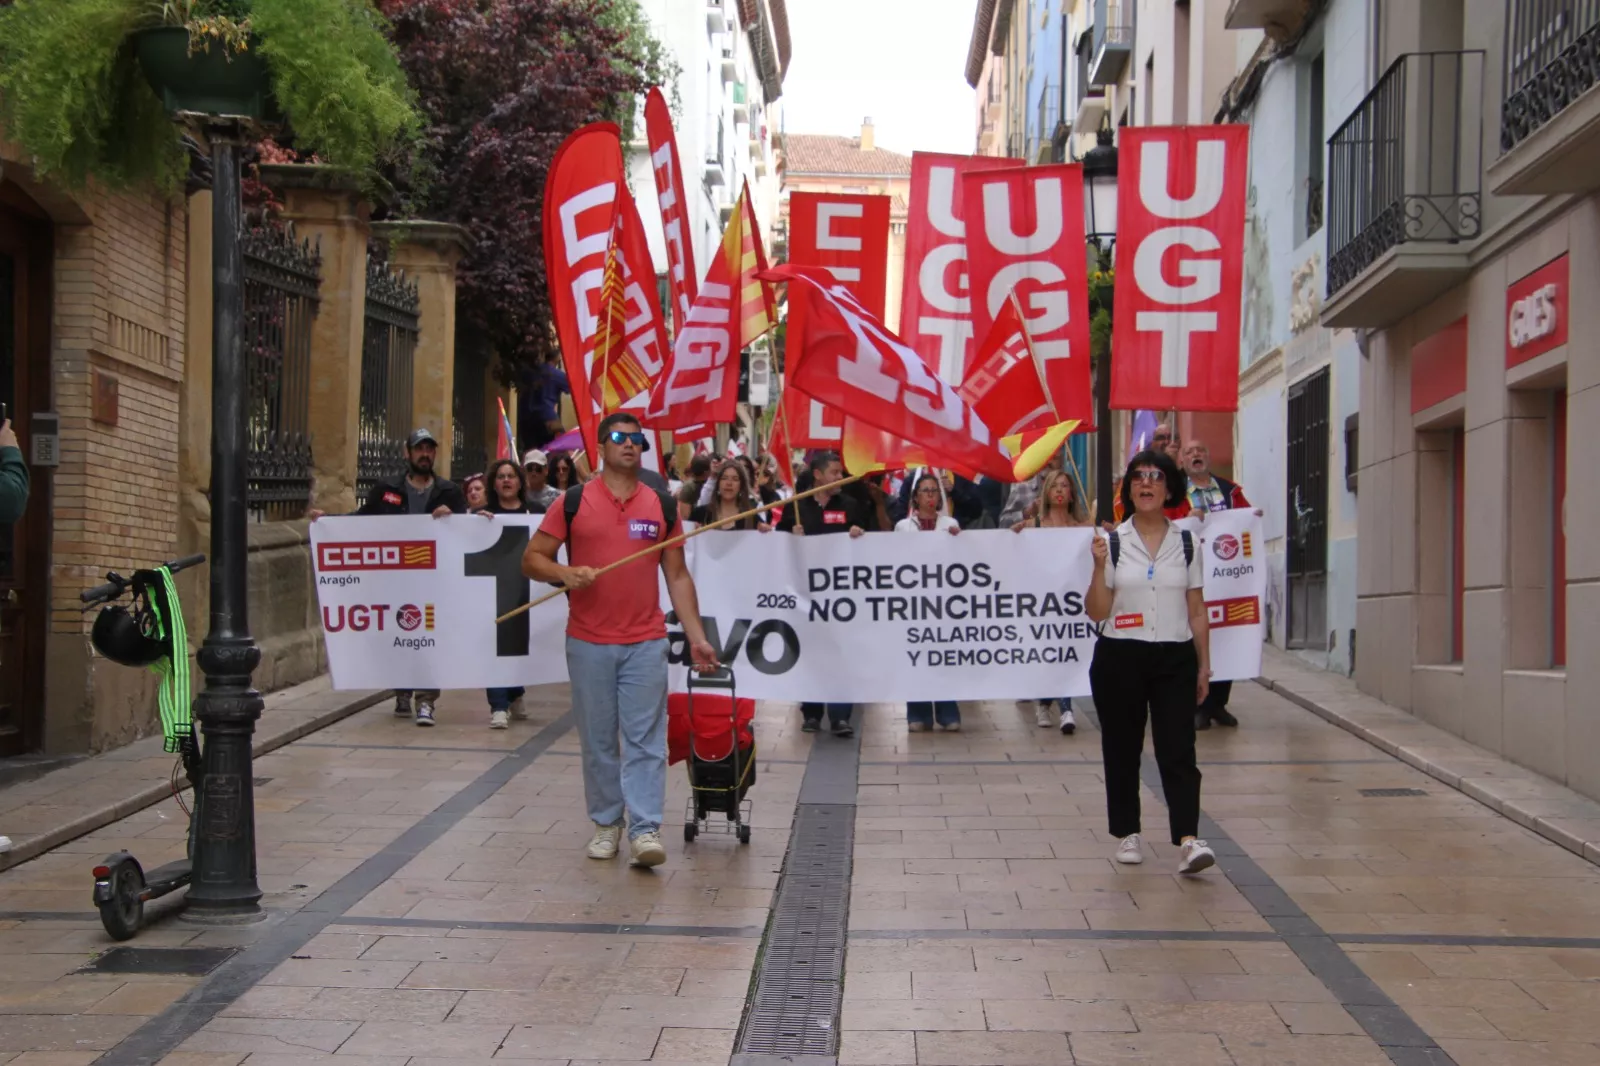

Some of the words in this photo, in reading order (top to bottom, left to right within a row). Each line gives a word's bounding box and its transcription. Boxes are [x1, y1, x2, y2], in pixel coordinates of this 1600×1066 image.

[1133, 139, 1226, 388] UGT
[650, 281, 731, 414] UGT
[631, 523, 648, 531] UGT
[323, 546, 400, 566] CCOO
[319, 574, 360, 587] Aragón
[808, 563, 1001, 592] DERECHOS,
[1212, 564, 1254, 579] Aragón
[464, 525, 530, 656] 1
[756, 594, 797, 609] 2026
[809, 597, 857, 622] NO
[323, 604, 390, 632] UGT
[393, 636, 435, 650] Aragón
[907, 625, 1023, 643] SALARIOS,
[1029, 622, 1100, 640] VIVIEN
[907, 650, 921, 667] Y
[928, 646, 1079, 667] DEMOCRACIA
